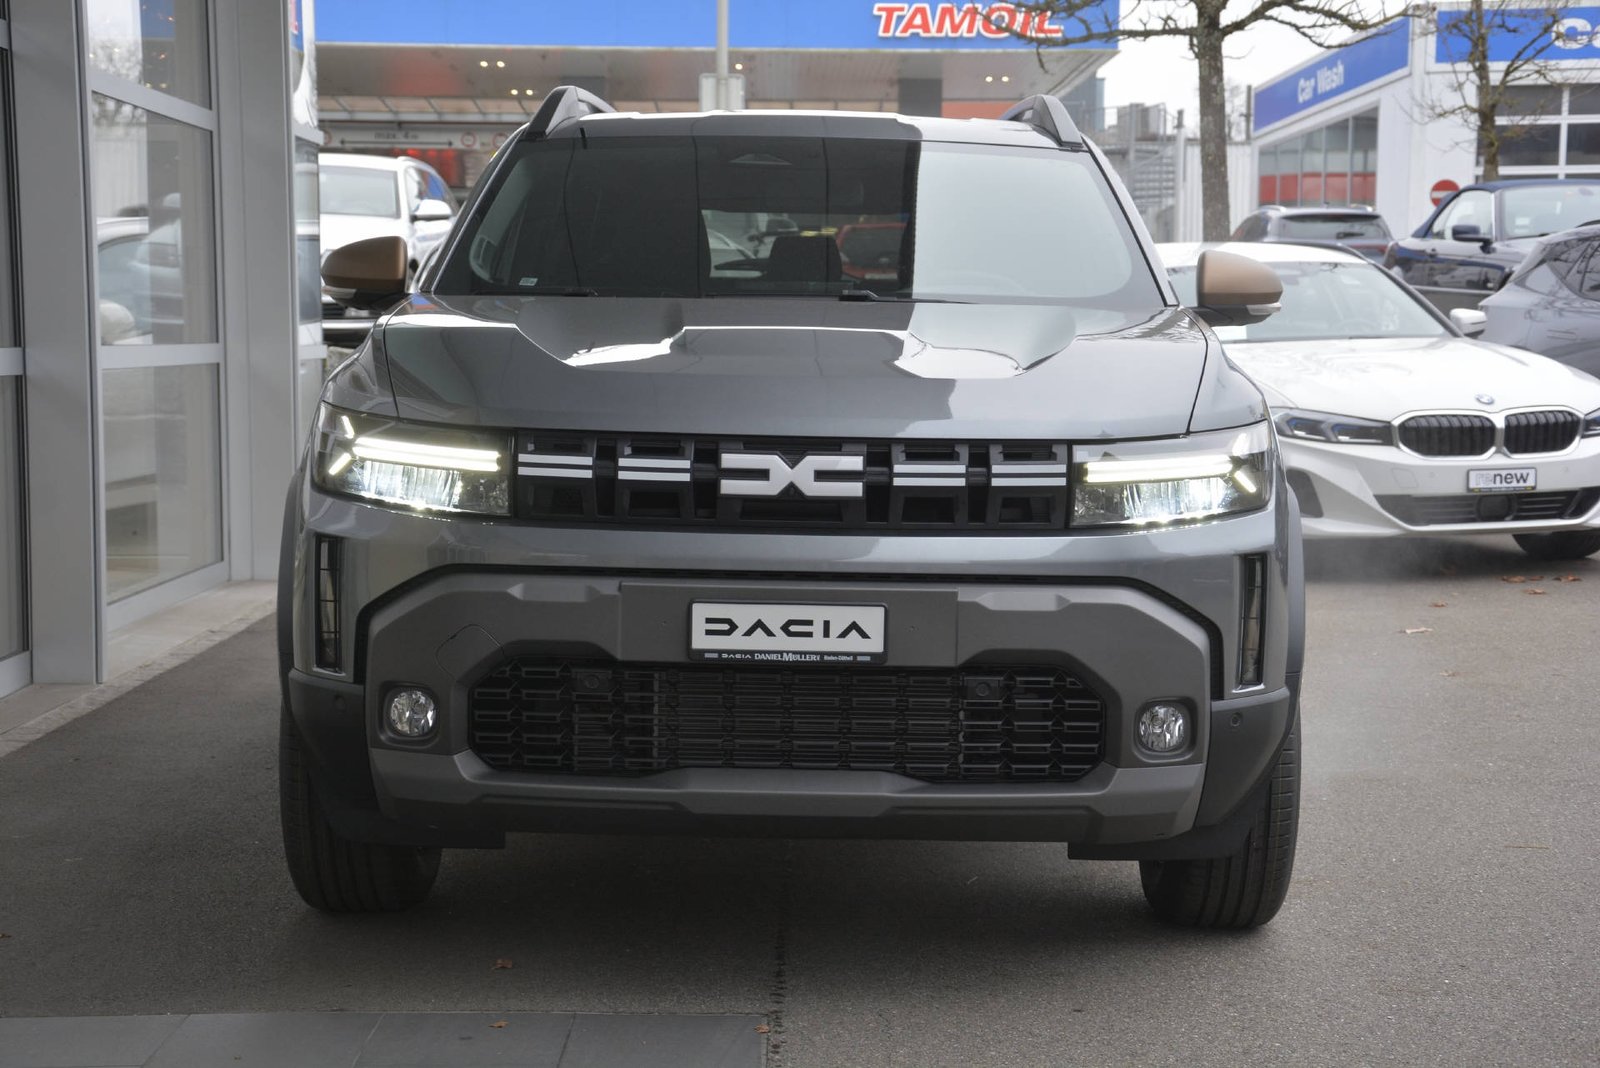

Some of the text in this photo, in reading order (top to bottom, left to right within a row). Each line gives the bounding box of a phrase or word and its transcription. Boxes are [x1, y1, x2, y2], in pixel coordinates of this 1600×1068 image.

[873, 3, 1064, 38] TAMOIL
[1552, 17, 1600, 49] C
[1298, 59, 1344, 104] Car Wash
[1475, 472, 1529, 486] renew
[705, 617, 872, 640] DACIA
